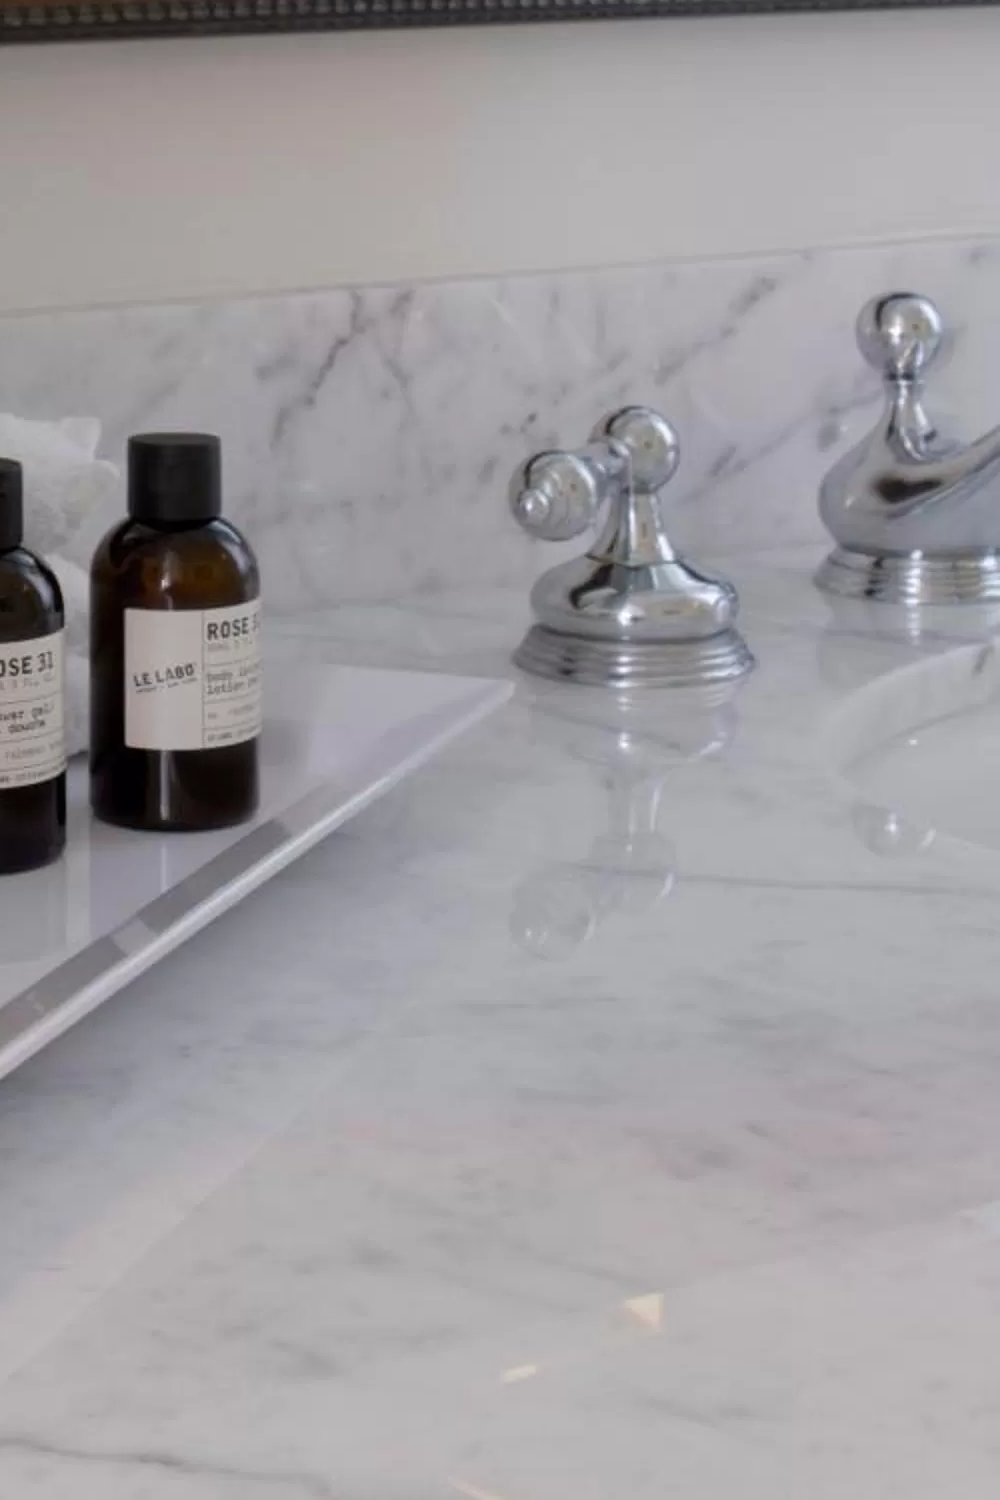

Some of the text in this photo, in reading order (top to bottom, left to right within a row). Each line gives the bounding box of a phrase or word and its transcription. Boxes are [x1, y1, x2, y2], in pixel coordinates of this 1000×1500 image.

[207, 617, 249, 641] ROSE
[37, 651, 54, 672] 31
[133, 672, 152, 687] LE
[155, 663, 195, 683] LABO
